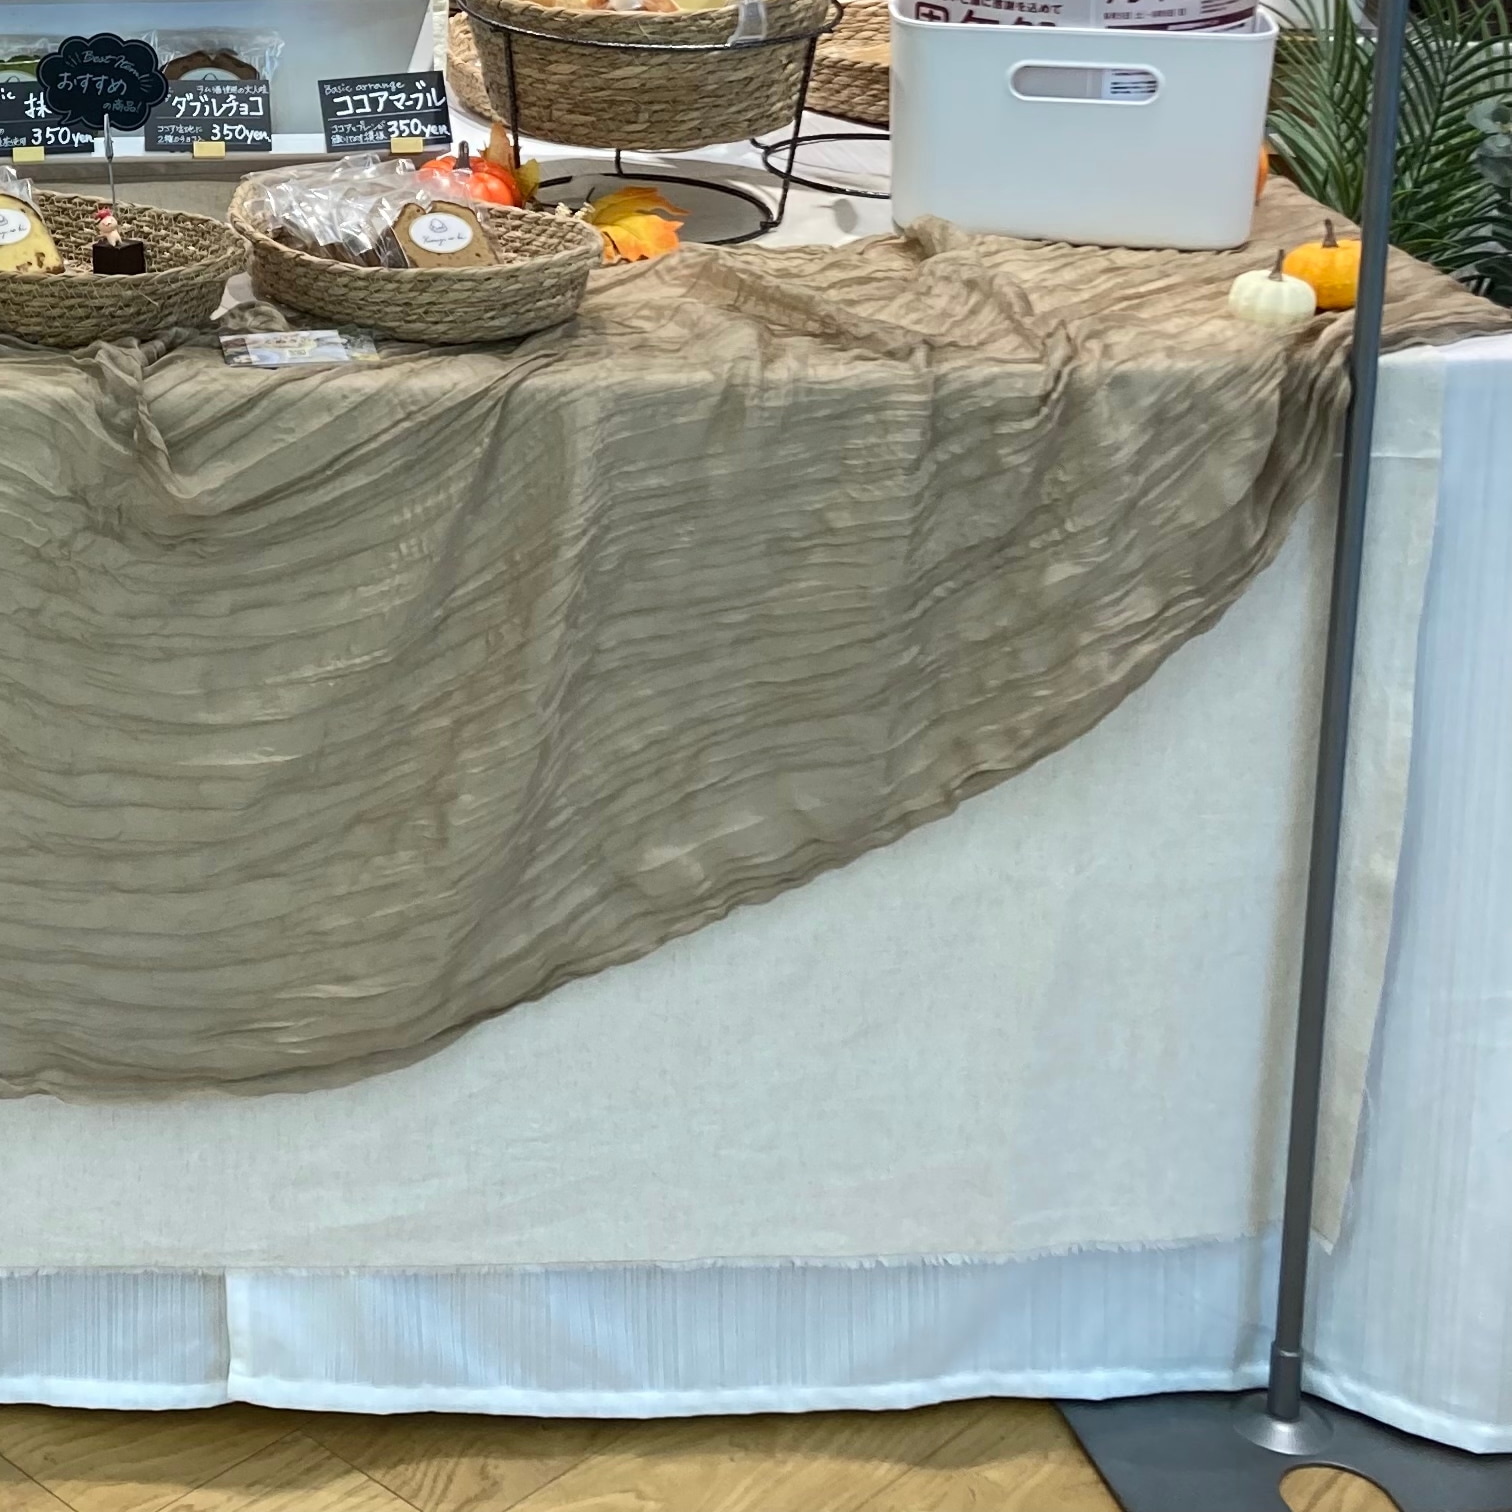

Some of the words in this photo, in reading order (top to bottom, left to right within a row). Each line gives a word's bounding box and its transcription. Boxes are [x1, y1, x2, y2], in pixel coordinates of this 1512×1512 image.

[57, 72, 128, 95] おすすめ
[324, 83, 353, 95] Basic
[24, 91, 53, 119] 抹
[172, 93, 264, 118] ダブルチョコ
[333, 79, 446, 116] ココアマーブル
